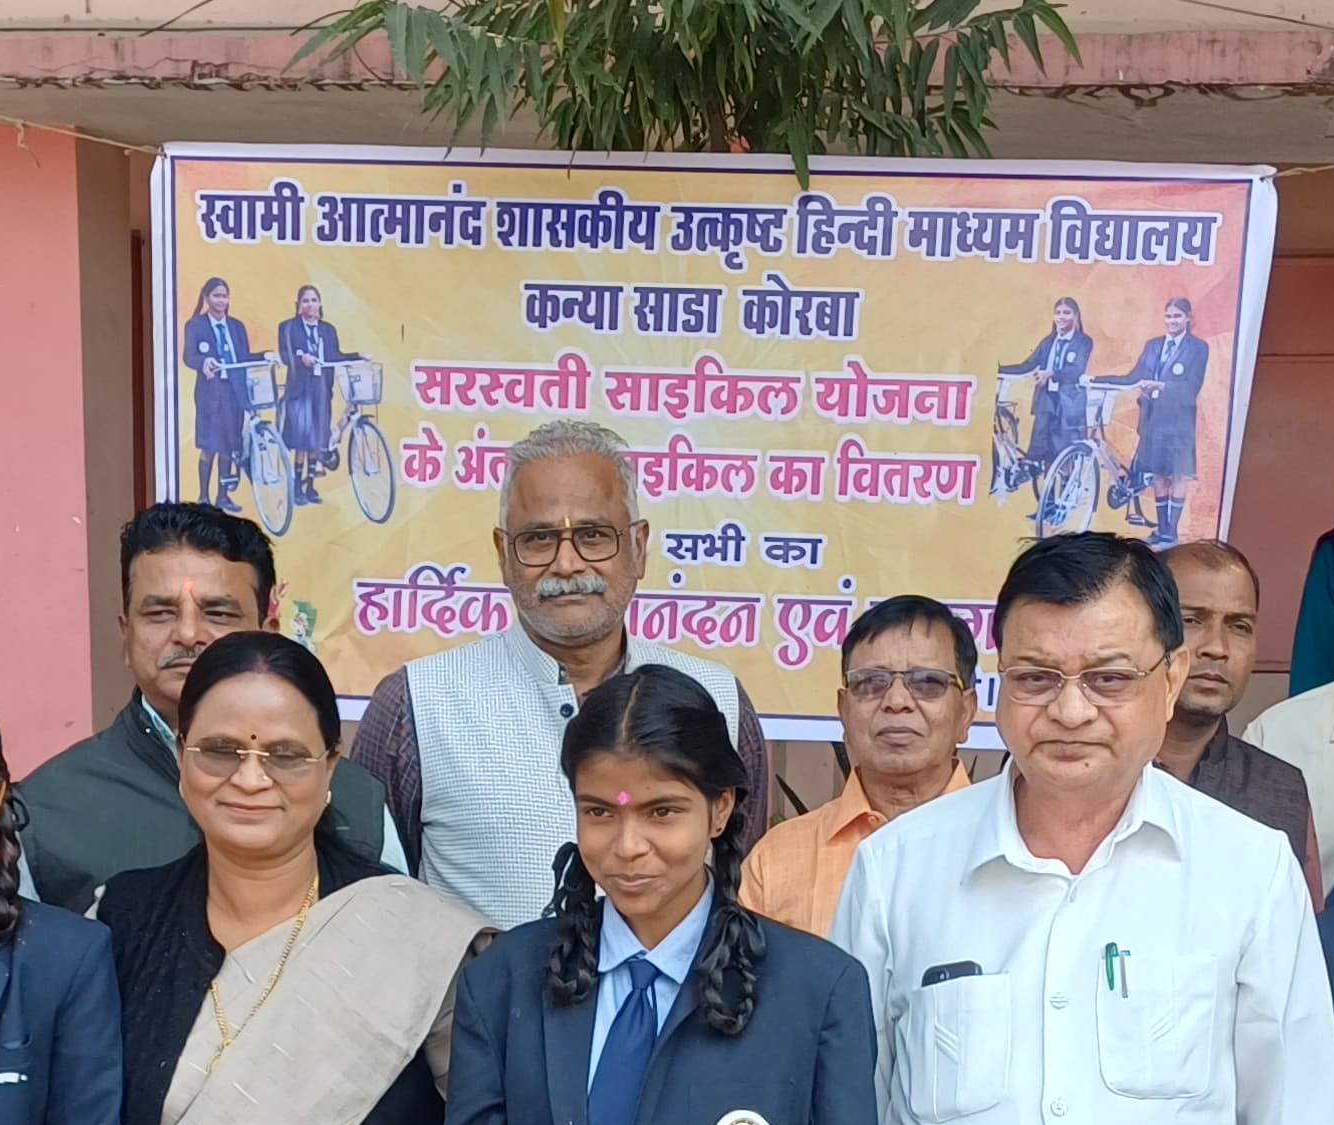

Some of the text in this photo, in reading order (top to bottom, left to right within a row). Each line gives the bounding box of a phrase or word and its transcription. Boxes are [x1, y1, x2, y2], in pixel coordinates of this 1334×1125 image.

[199, 181, 1218, 269] स्वामी आत्मानंद शासकीय उत्कृष्ट हिन्दी माध्यम विद्यालय
[524, 274, 859, 337] कन्या साडा कोरबा
[414, 355, 971, 420] सरस्वती साइकिल योजना
[403, 427, 443, 482] के
[622, 434, 758, 497] ाइकिल
[769, 454, 825, 496] का
[837, 439, 976, 499] वितरण
[666, 523, 822, 565] सभी का
[357, 565, 511, 634] हार्दिक
[777, 578, 852, 666] एवं
